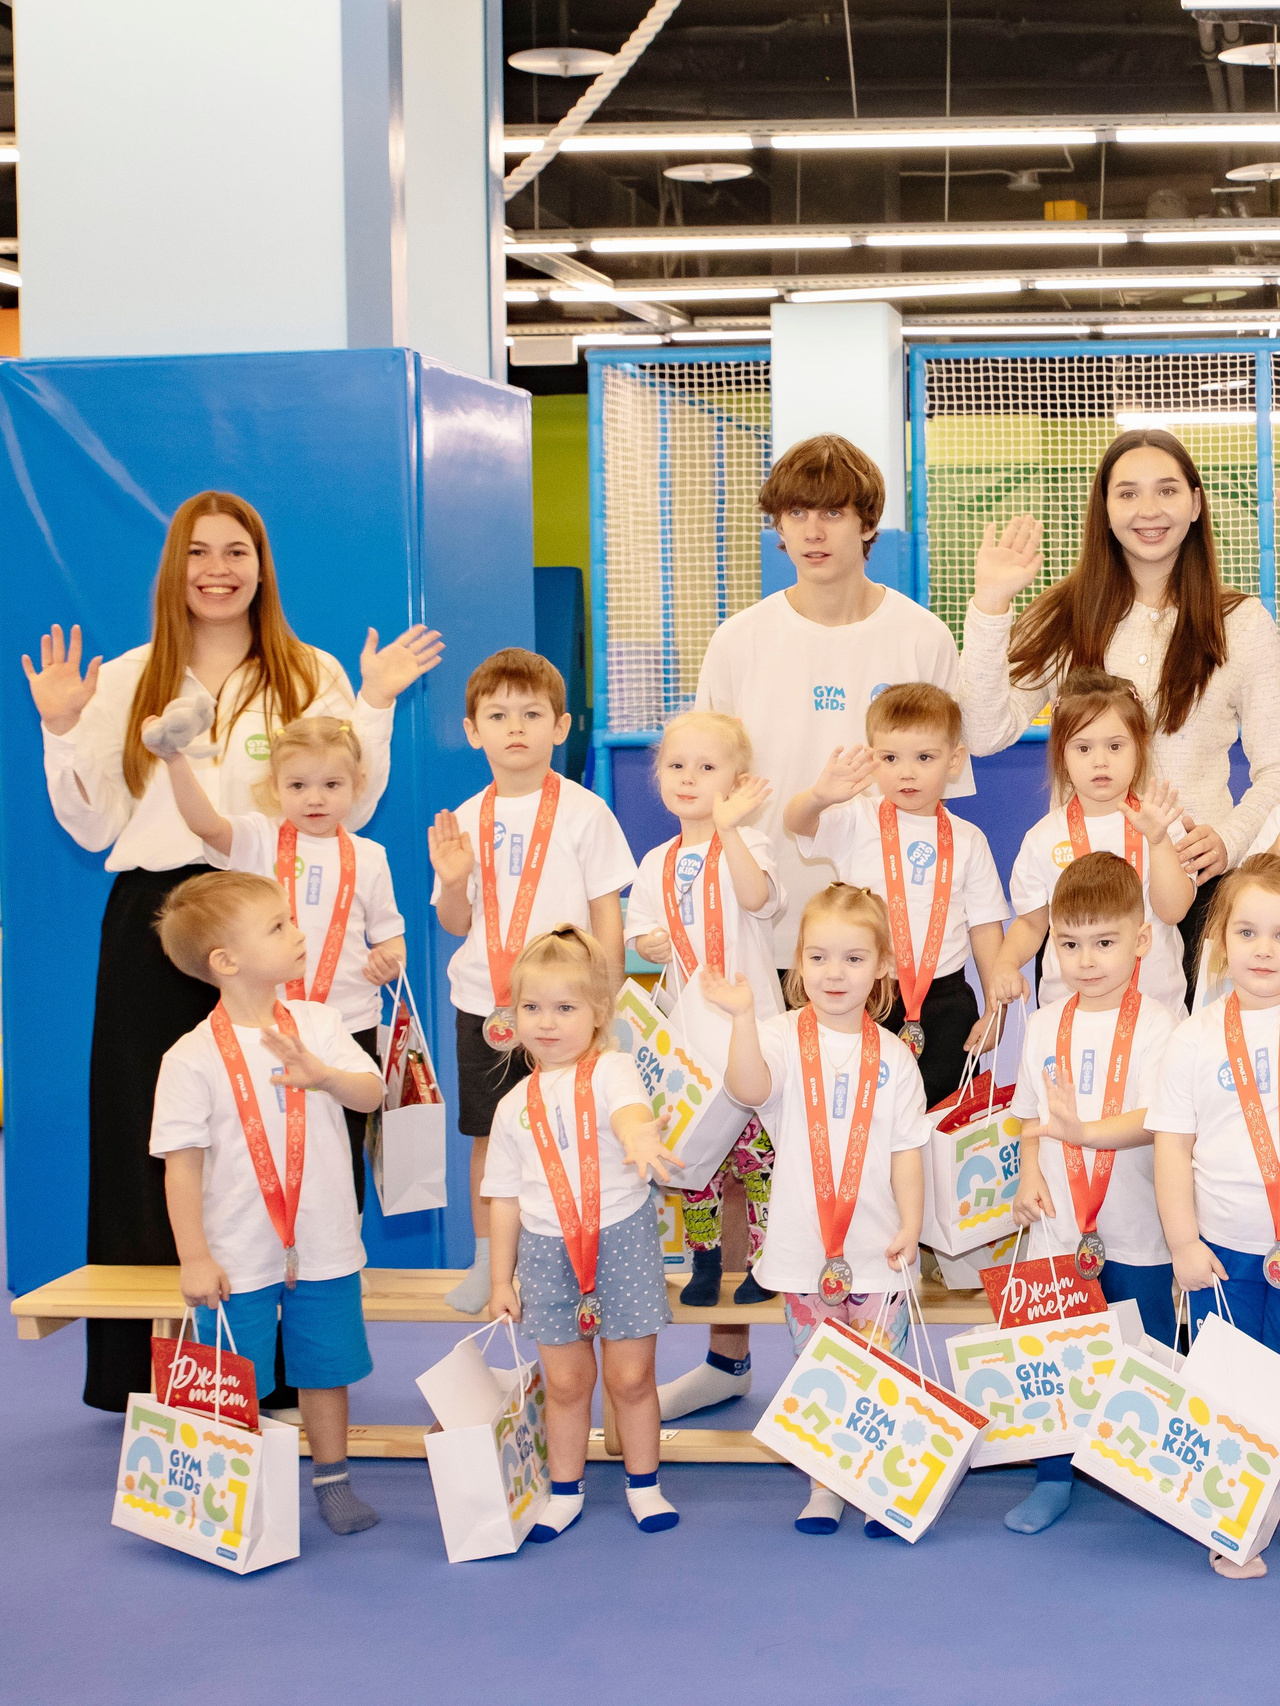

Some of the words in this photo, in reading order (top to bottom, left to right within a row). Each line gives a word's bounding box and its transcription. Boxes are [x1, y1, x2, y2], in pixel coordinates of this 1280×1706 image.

[813, 685, 846, 699] GYM
[814, 698, 846, 712] KiDs
[680, 858, 701, 869] GYM
[916, 845, 934, 866] GYM
[1055, 854, 1074, 865] KiD
[637, 1046, 666, 1084] GYM
[1113, 1054, 1123, 1082] GYMKiDs
[1236, 1057, 1248, 1086] GYMKiDs
[809, 1077, 819, 1106] GYMKiDs
[861, 1080, 872, 1108] GYMKiDs
[536, 1121, 548, 1148] GYMKiDs
[998, 1140, 1020, 1164] GY
[1001, 1159, 1021, 1182] Ki
[1001, 1276, 1074, 1314] Джип
[1027, 1290, 1089, 1322] тест
[1015, 1360, 1062, 1382] GYM
[1020, 1379, 1065, 1401] KiDs
[855, 1396, 896, 1437] GYM
[515, 1422, 530, 1448] GYM
[845, 1412, 888, 1452] KiDs
[1168, 1417, 1211, 1457] GYM
[169, 1449, 203, 1478] GYM
[518, 1440, 535, 1466] KiDs
[1161, 1433, 1205, 1473] KiDs
[168, 1468, 202, 1496] KiDs
[1212, 1532, 1238, 1550] gymkids.ru
